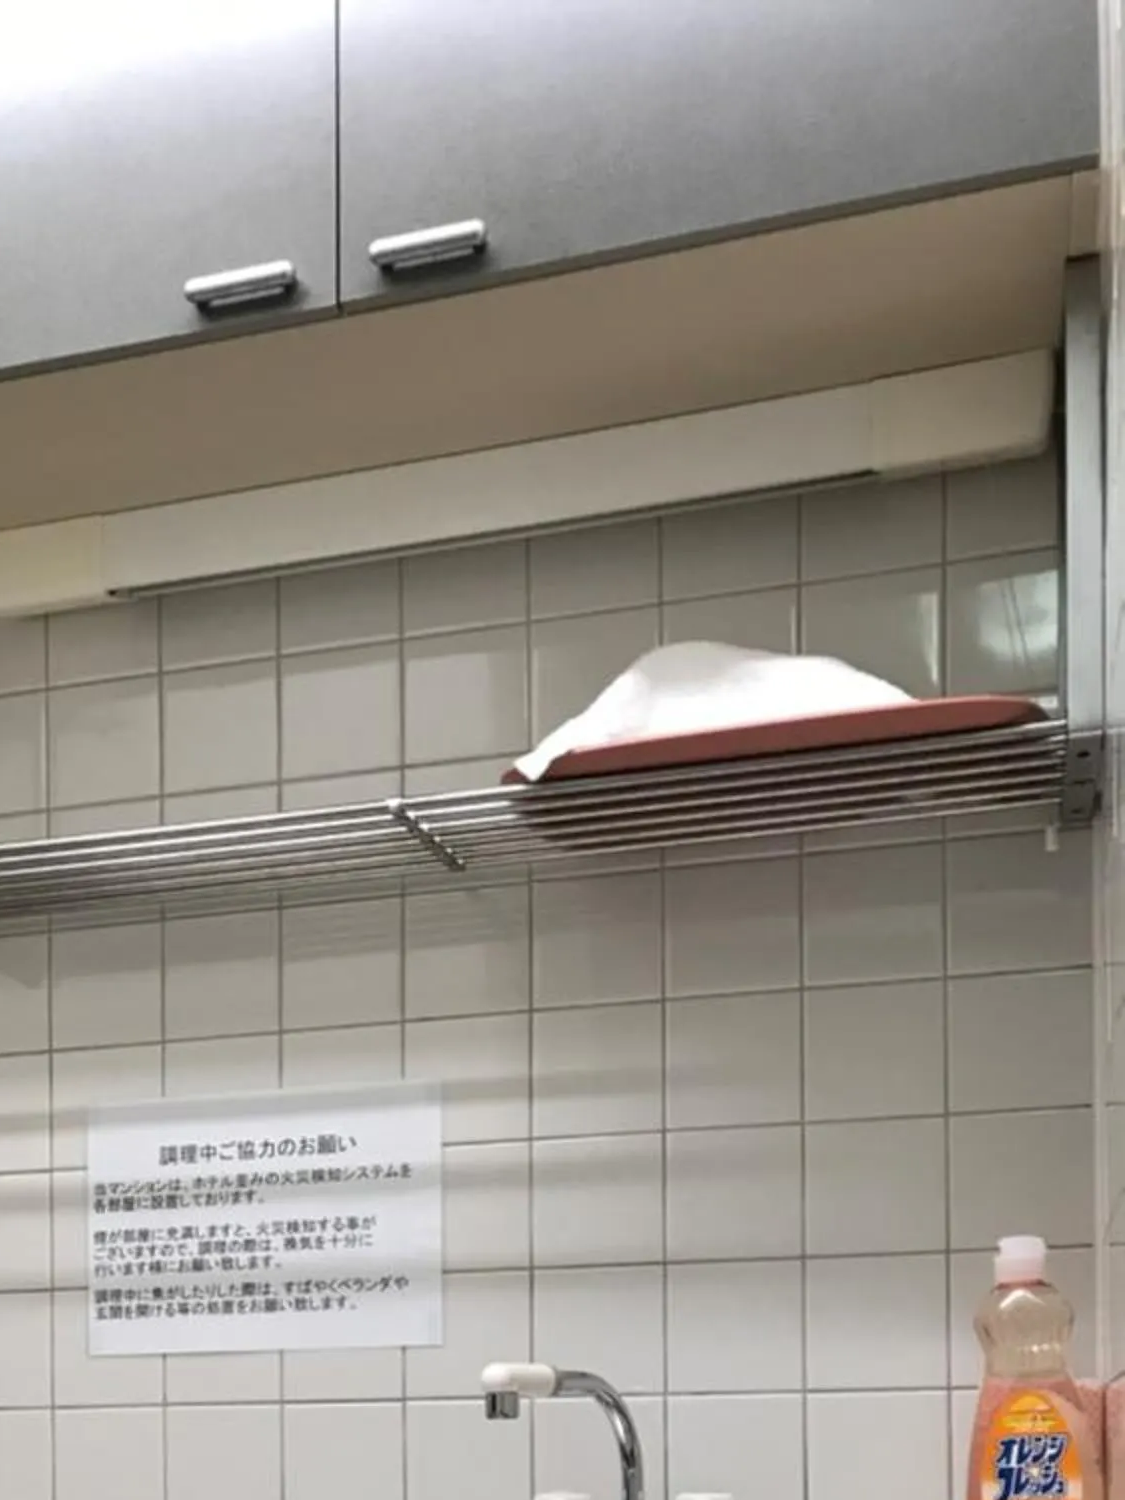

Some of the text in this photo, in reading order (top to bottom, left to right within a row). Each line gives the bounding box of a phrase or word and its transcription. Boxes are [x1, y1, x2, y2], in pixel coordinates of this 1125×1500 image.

[159, 1134, 357, 1166] 調理中ご協力のお願い
[996, 1435, 1067, 1466] オレンジ
